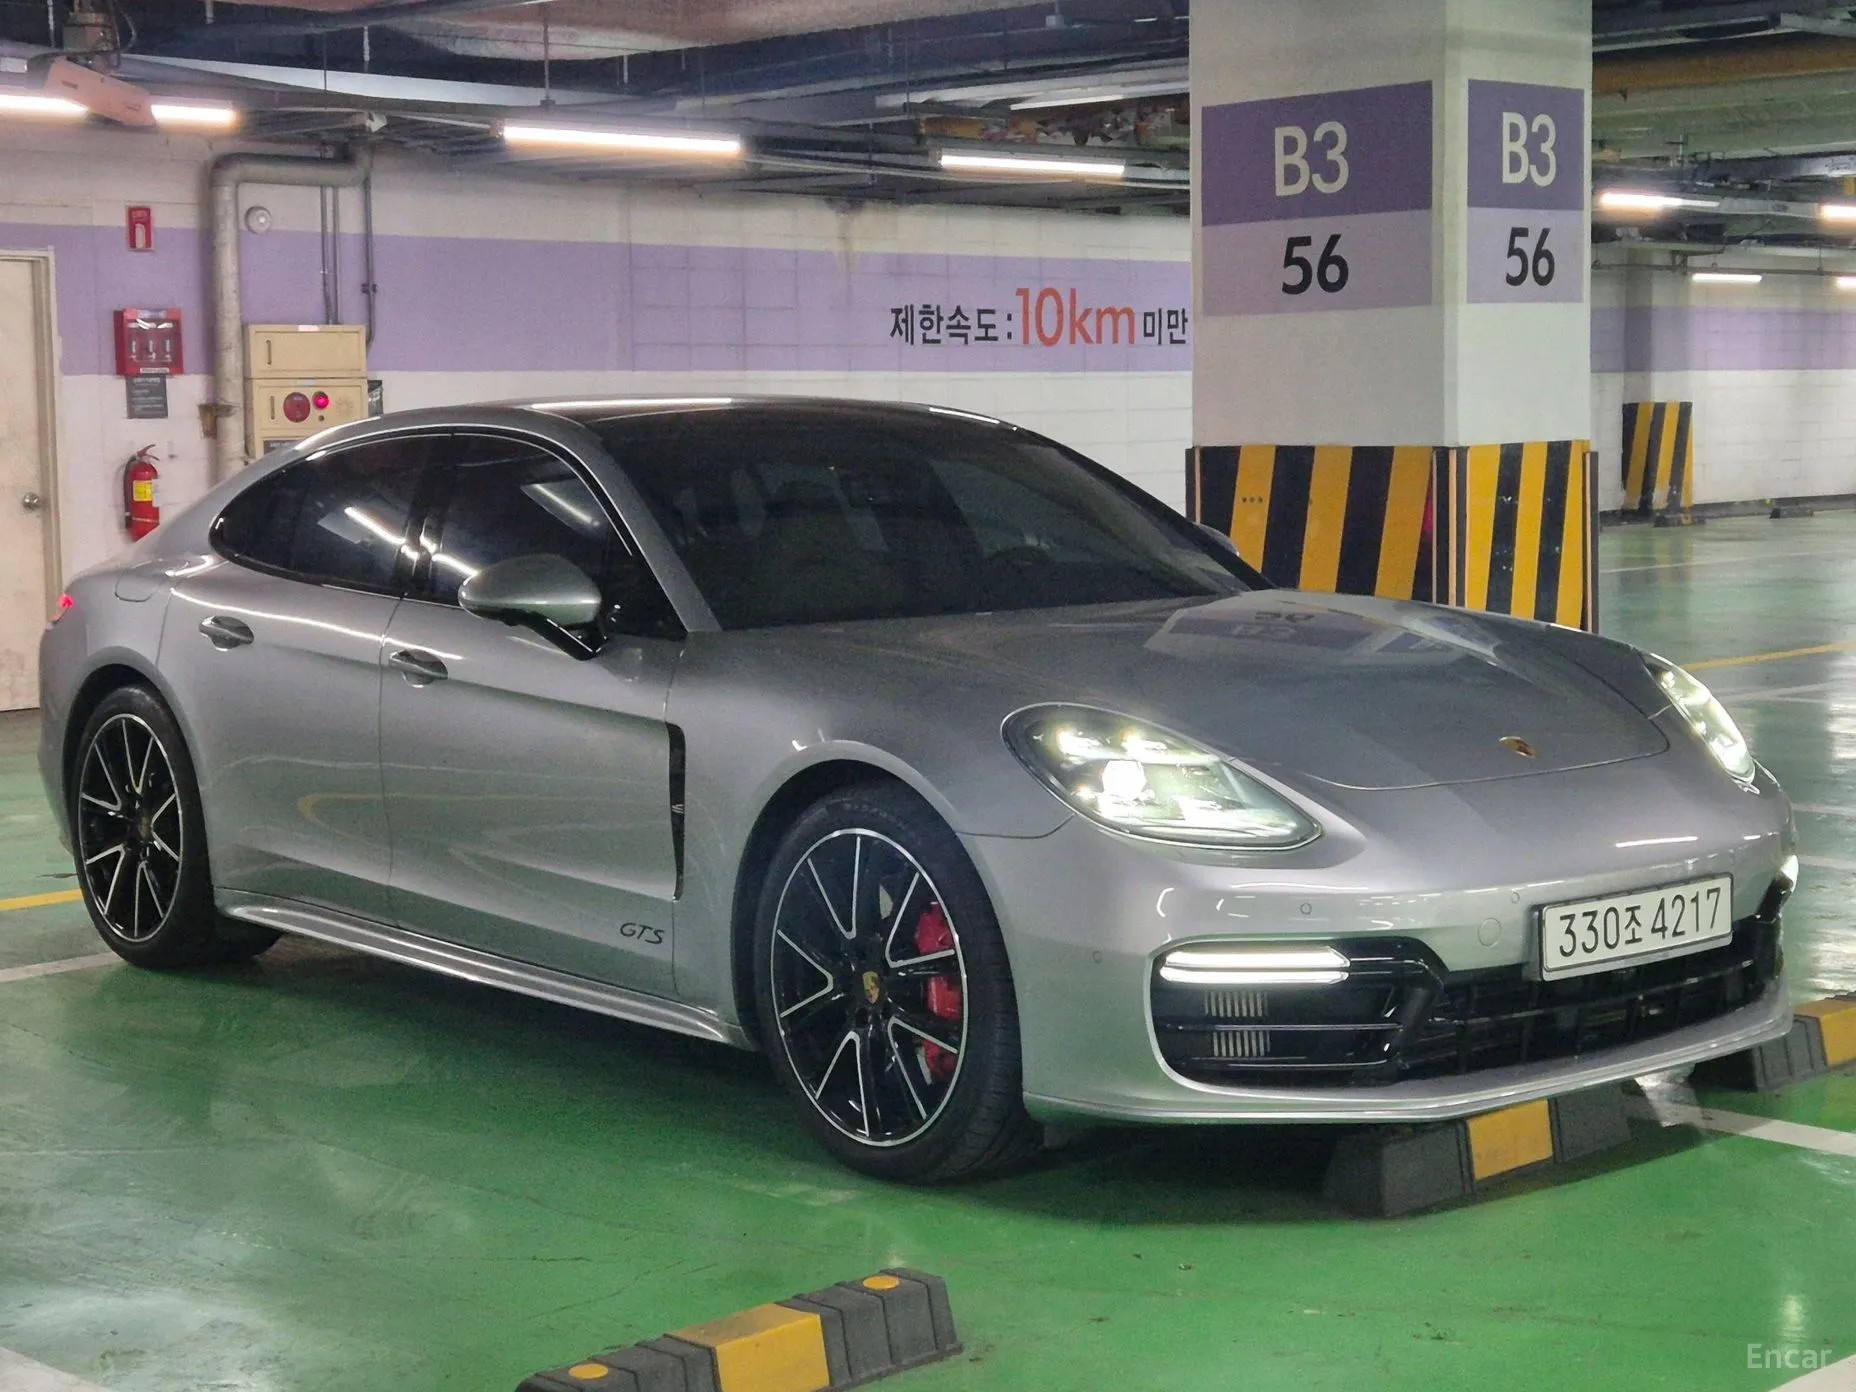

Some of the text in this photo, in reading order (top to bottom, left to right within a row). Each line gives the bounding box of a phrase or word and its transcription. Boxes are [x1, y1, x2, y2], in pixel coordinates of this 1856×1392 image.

[1274, 121, 1350, 197] B3
[1502, 111, 1557, 187] B3
[1281, 233, 1349, 295] 56
[1505, 227, 1555, 287] 56
[1015, 287, 1136, 347] 10km
[1143, 307, 1189, 345] 미만
[620, 922, 665, 945] GTS
[1559, 887, 1721, 958] 330조 4217
